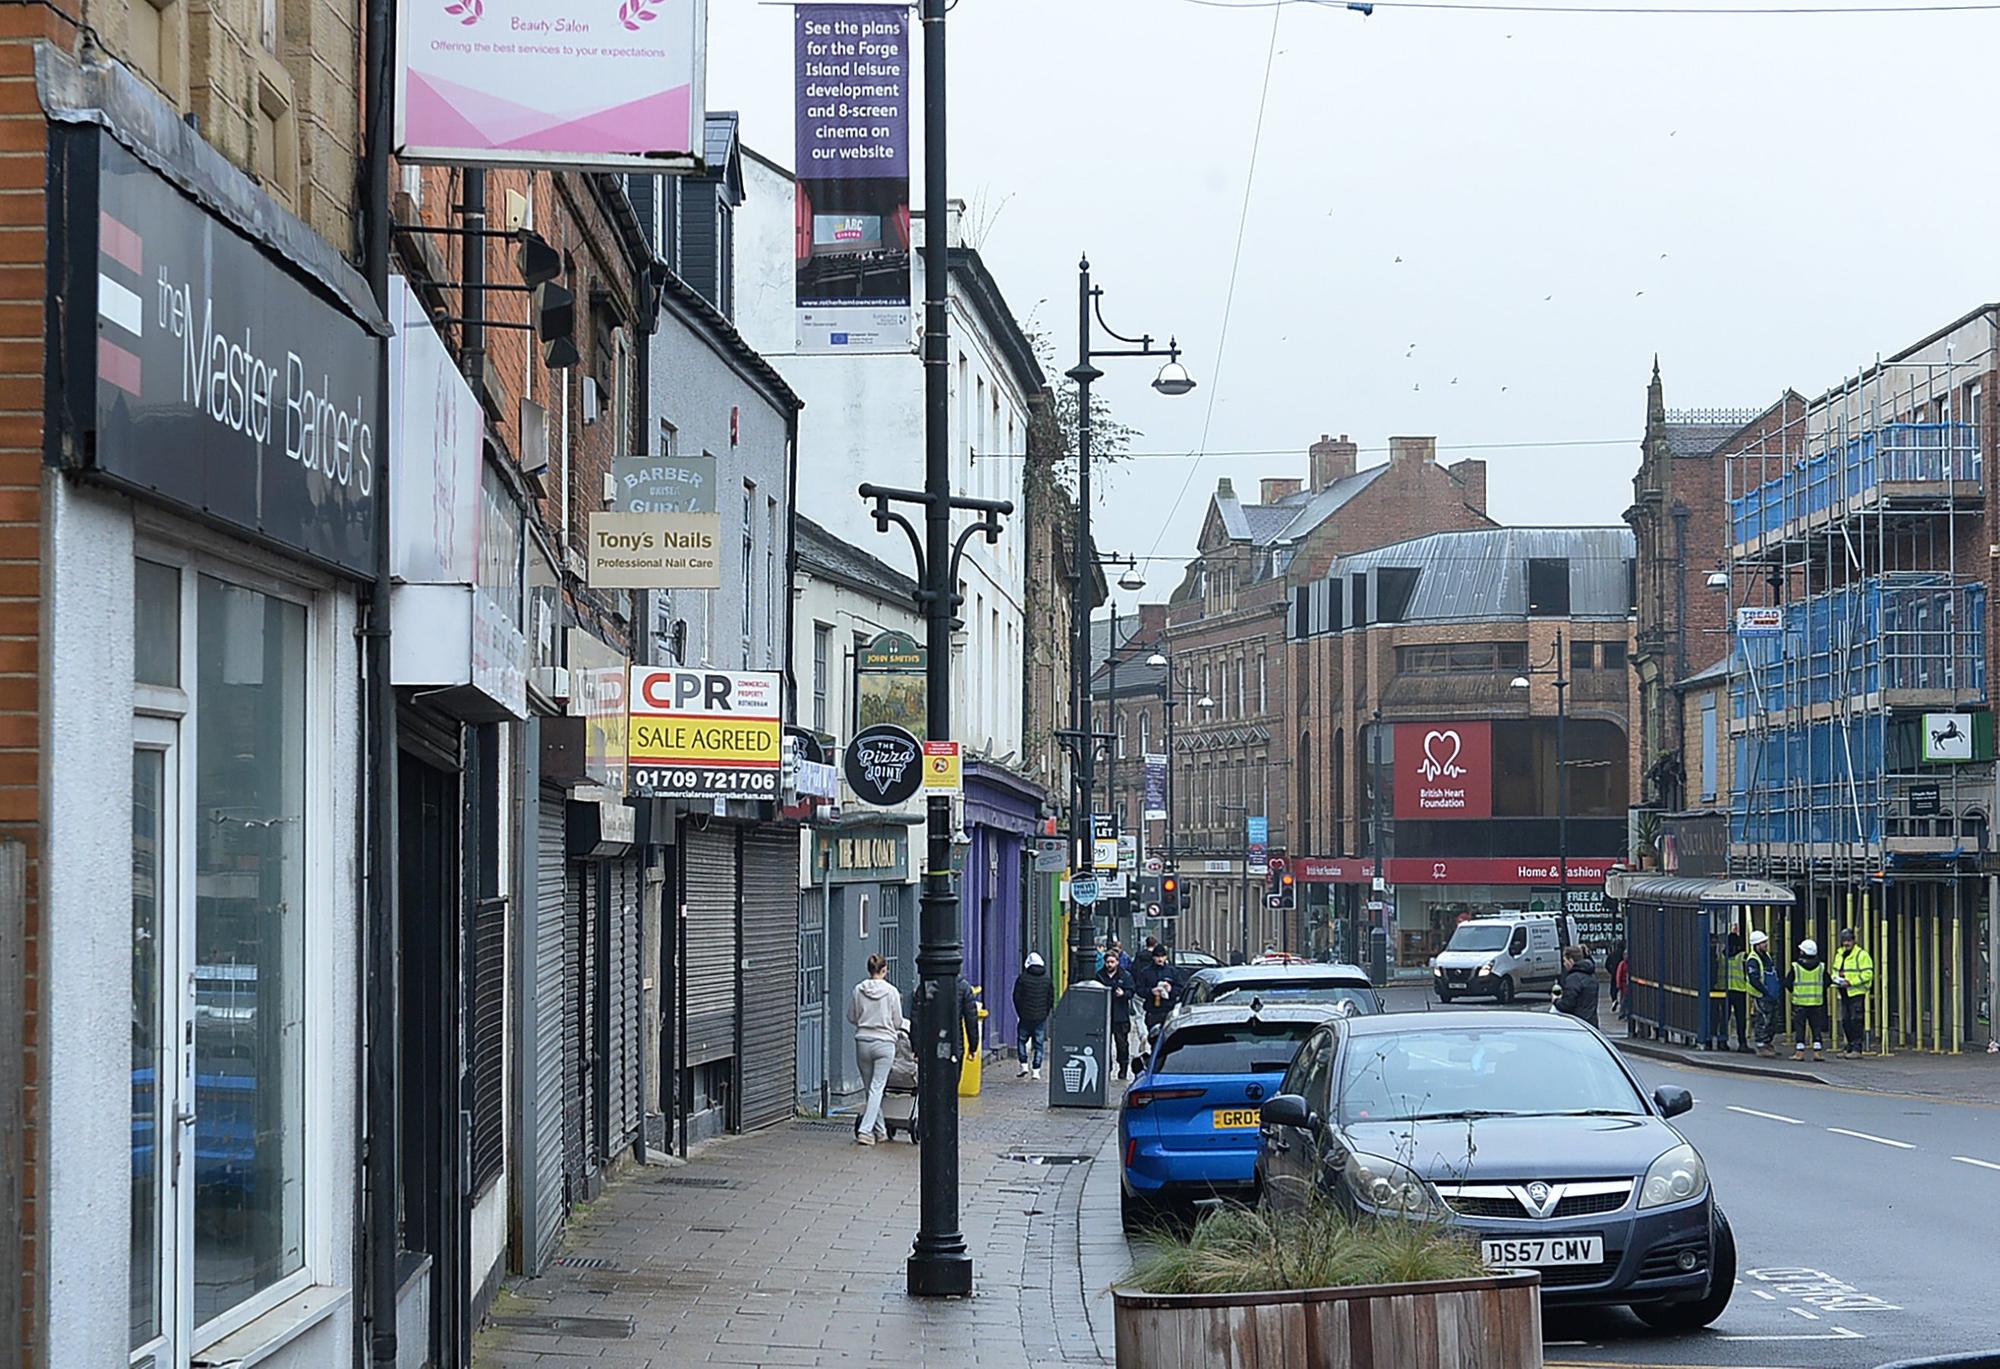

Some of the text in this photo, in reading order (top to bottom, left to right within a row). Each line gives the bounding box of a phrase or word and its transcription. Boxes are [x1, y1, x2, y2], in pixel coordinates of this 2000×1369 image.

[511, 16, 590, 35] Beauty Salon
[805, 20, 900, 38] See the plans
[430, 40, 665, 59] Offering the best services to your expectations
[807, 41, 899, 59] for the Forge
[805, 62, 900, 76] Island leisure
[806, 82, 900, 100] development
[807, 103, 898, 118] and 8-screen
[815, 125, 890, 138] cinema on
[812, 144, 894, 159] our website
[845, 218, 863, 231] ABC
[157, 265, 184, 338] the
[183, 283, 278, 445] Master
[286, 350, 372, 496] Barber's
[624, 467, 703, 489] BARBER
[596, 531, 712, 551] Tony's Nails
[596, 558, 714, 569] Professional Nail Care
[642, 672, 732, 710] CPR
[637, 726, 771, 752] SALE AGREED
[877, 741, 895, 749] THE
[862, 750, 911, 765] Pizza
[636, 769, 775, 790] 01709 721706
[868, 765, 901, 779] JOINT
[1420, 789, 1465, 798] British Heart
[1420, 798, 1465, 808] Foundation
[1096, 828, 1113, 837] LET
[1518, 865, 1601, 877] Home & ashion
[1567, 891, 1589, 901] FREE
[1489, 1240, 1592, 1262] DS57 CMV
